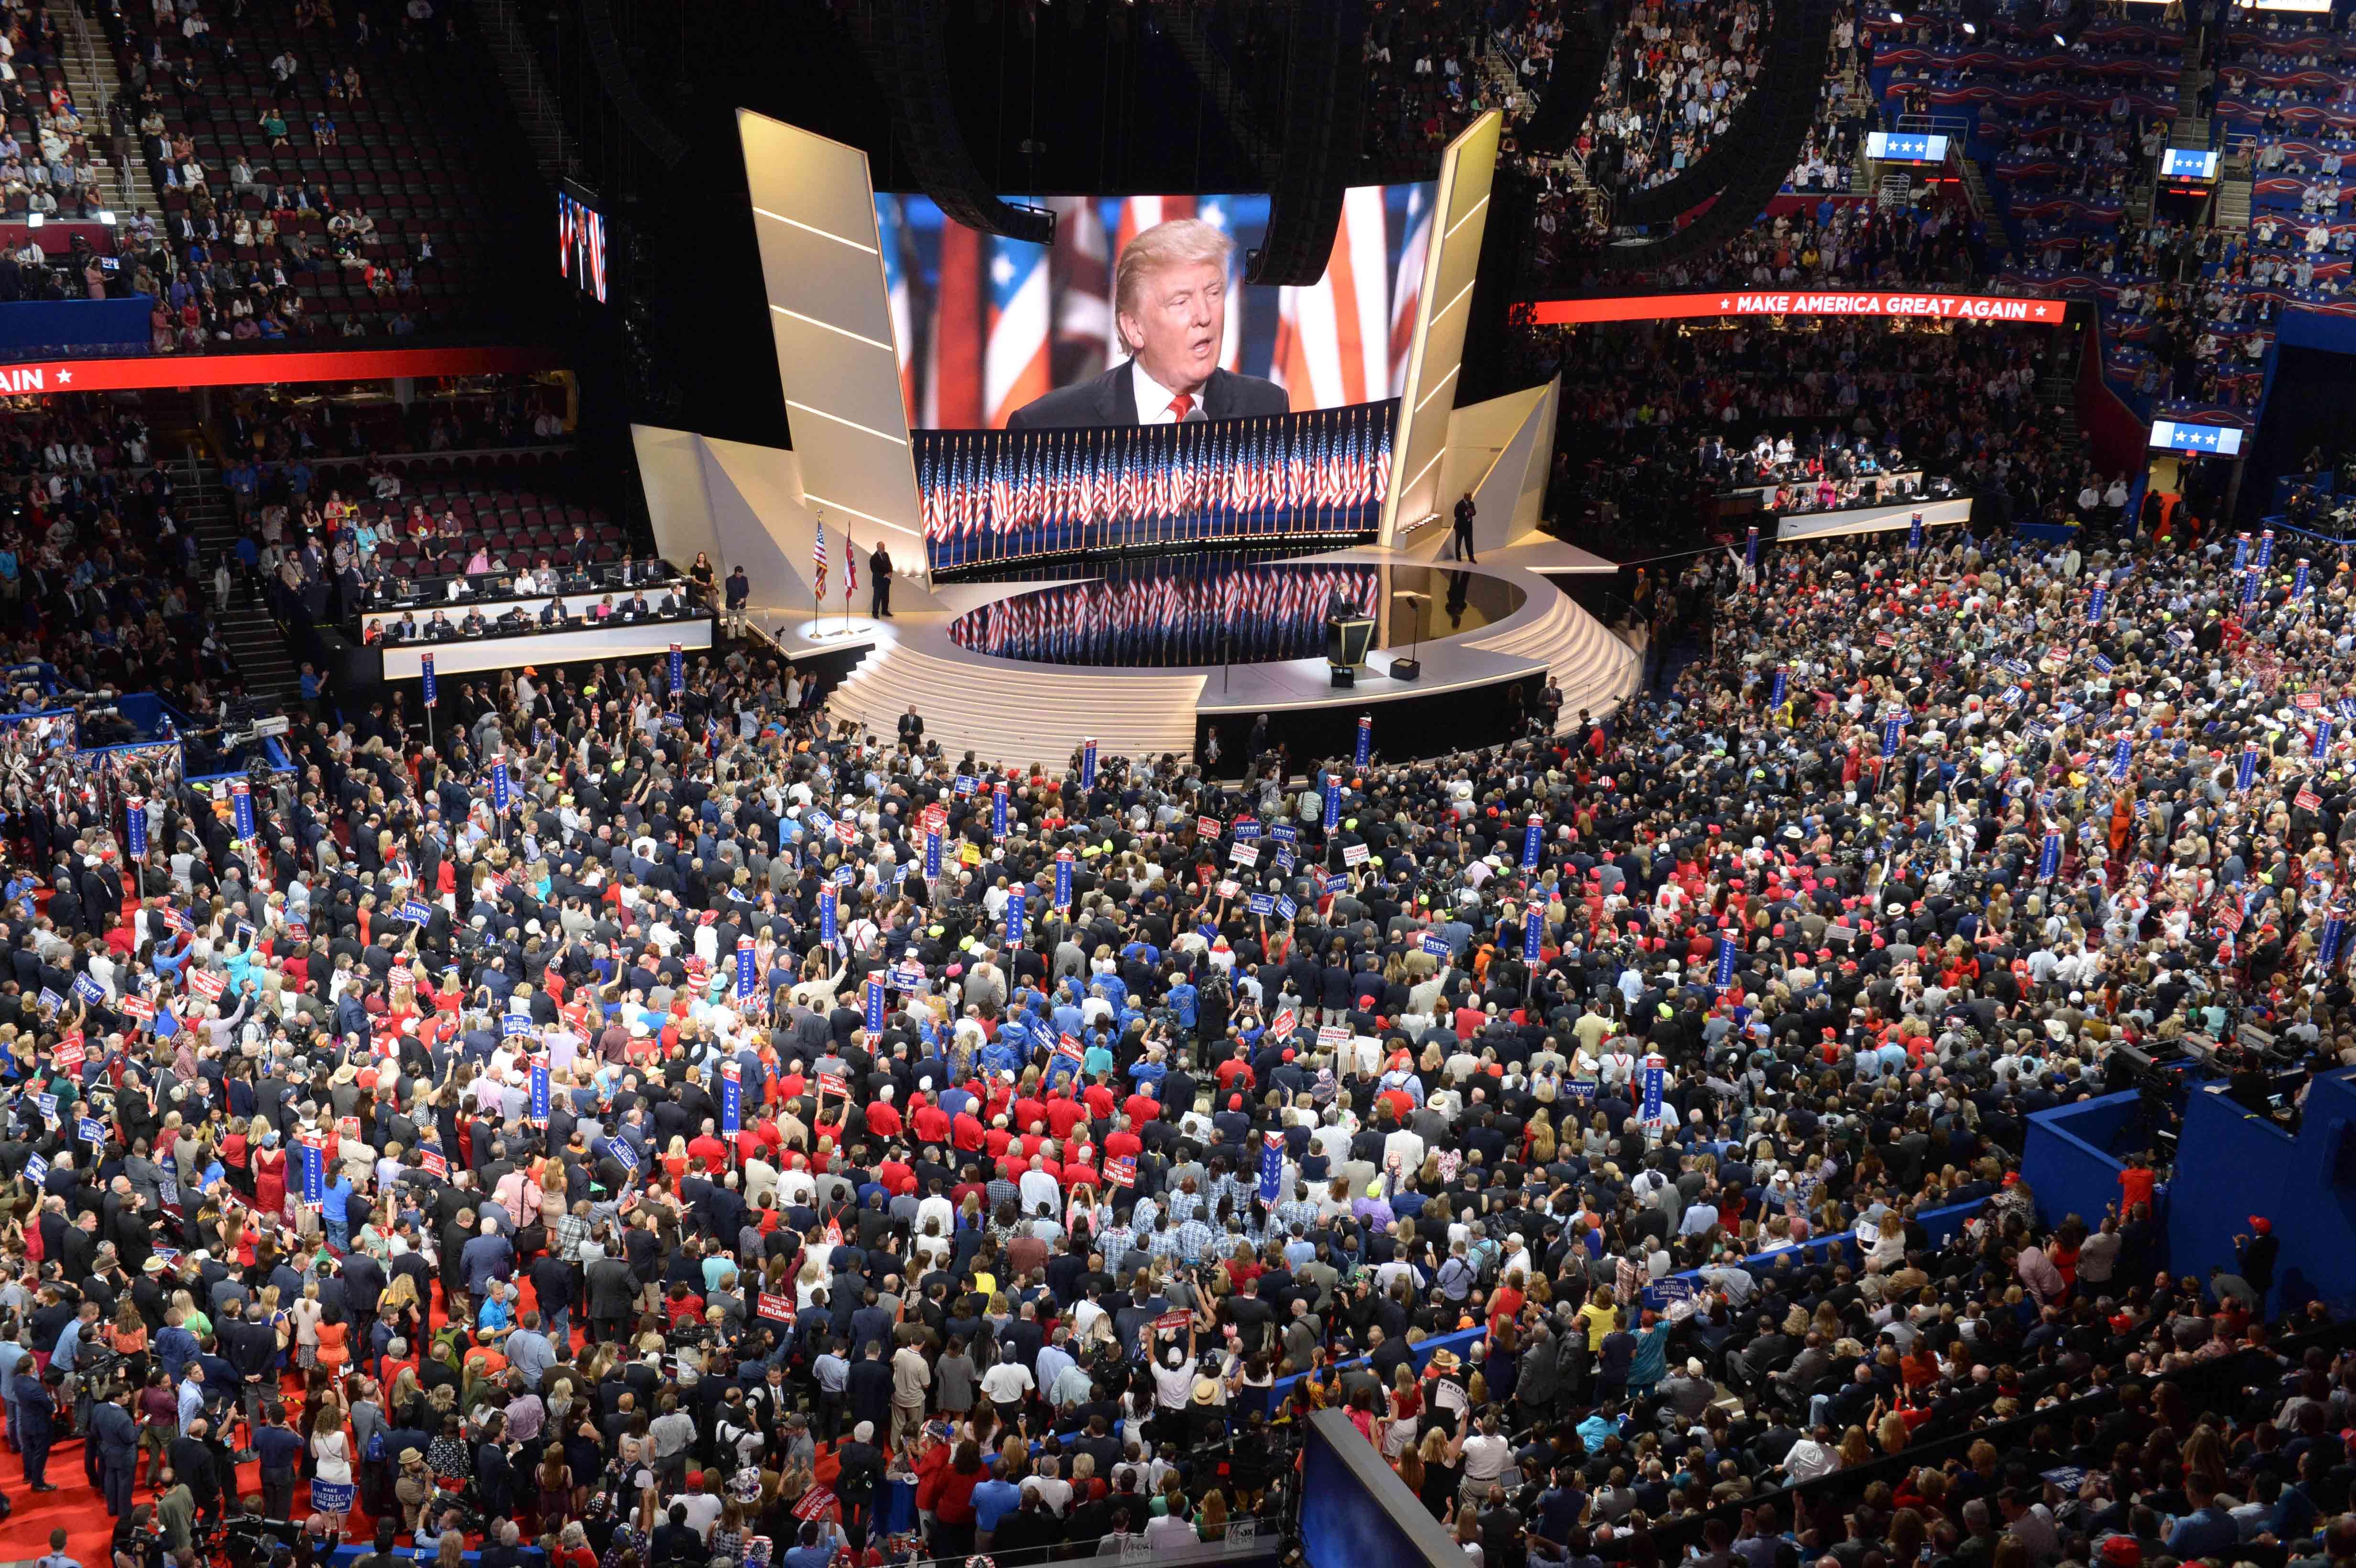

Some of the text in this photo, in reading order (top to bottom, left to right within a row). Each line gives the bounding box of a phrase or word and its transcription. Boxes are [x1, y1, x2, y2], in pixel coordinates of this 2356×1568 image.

[1737, 295, 2028, 319] MAKE AMERICA GREAT AGAIN
[497, 767, 505, 801] OREGON
[956, 780, 978, 788] AMERICA
[239, 795, 247, 835] MISSISSIPPI
[1200, 823, 1219, 831] AMERICA
[1233, 845, 1257, 855] TRUMP
[1344, 846, 1366, 855] TRUMP
[1528, 828, 1537, 861] FLORIDA
[1327, 878, 1347, 886] TRUMP
[1252, 900, 1272, 908] AMERICA
[407, 905, 429, 916] TRUMP
[164, 917, 181, 926] TRUMP
[1426, 940, 1449, 948] TRUMP
[1722, 942, 1730, 983] TENNESSEE
[78, 977, 101, 996] TRUMP
[193, 980, 221, 996] TRUMP
[130, 997, 149, 1006] WOMEN
[124, 1004, 153, 1016] TRUMP
[504, 1020, 531, 1029] AMERICA
[1042, 1024, 1055, 1040] WOMEN
[1034, 1027, 1055, 1050] TRUMP
[1064, 1035, 1080, 1048] FAMILIES
[57, 1047, 83, 1056] AMERICA
[1059, 1042, 1082, 1059] TRUMP
[823, 1075, 842, 1085] FAMILIES
[821, 1083, 846, 1094] TRUMP
[81, 1125, 104, 1138] AMERICA
[613, 1141, 635, 1165] AMERICA
[1109, 1162, 1131, 1173] FAMILIES
[1104, 1169, 1134, 1184] TRUMP
[764, 1296, 789, 1307] FAMILIES
[759, 1305, 792, 1320] TRUMP
[2050, 1468, 2080, 1477] WOMEN
[313, 1490, 351, 1502] AMERICA
[796, 1486, 825, 1515] HISPANICS
[804, 1493, 835, 1521] TRUMP
